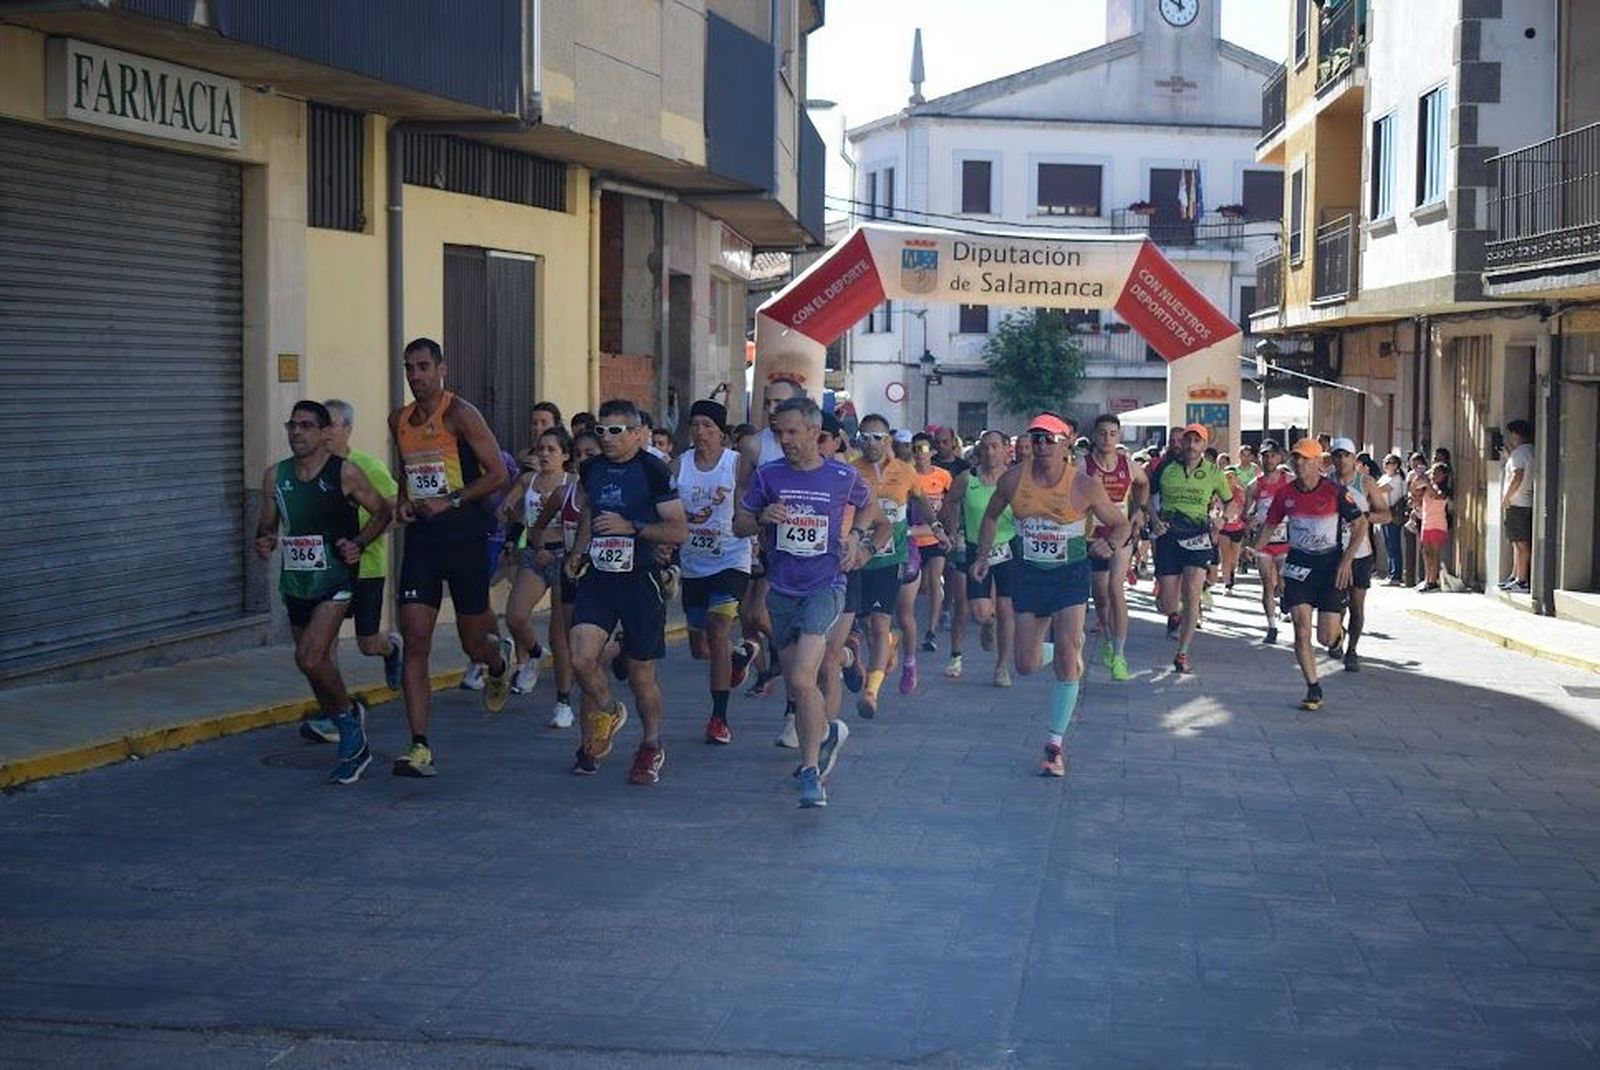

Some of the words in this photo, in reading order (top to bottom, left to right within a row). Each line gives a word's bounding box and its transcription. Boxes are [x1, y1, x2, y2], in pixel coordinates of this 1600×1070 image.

[74, 52, 239, 140] FARMACIA
[953, 241, 1081, 267] Diputación
[792, 303, 816, 324] CON
[812, 295, 828, 309] EL
[824, 259, 870, 299] DEPORTE
[950, 275, 971, 291] de
[980, 271, 1104, 297] Salamanca
[1139, 269, 1162, 292] CON
[1159, 288, 1212, 339] NUESTROS
[1130, 284, 1196, 346] DEPORTISTAS
[416, 475, 438, 489] 356
[691, 536, 714, 549] 432
[786, 527, 817, 543] 438
[290, 548, 316, 561] 366
[598, 549, 623, 563] 482
[1032, 540, 1058, 554] 393
